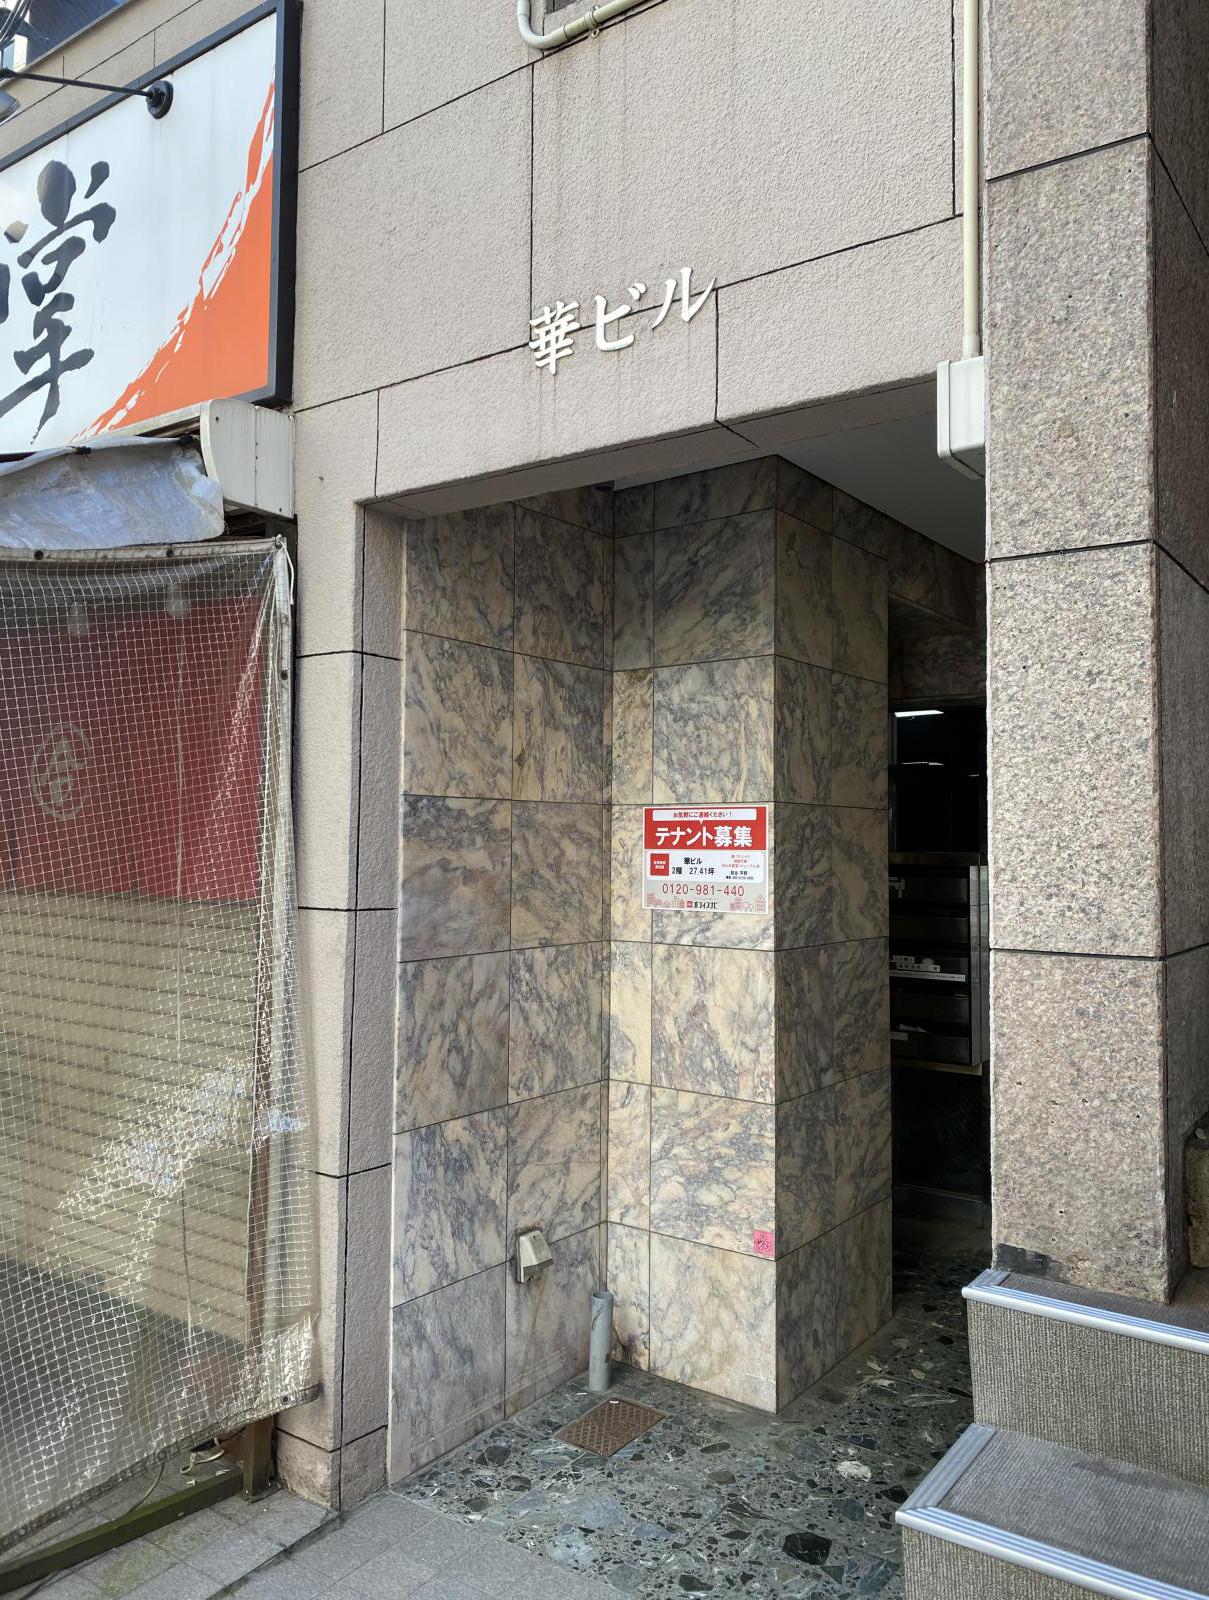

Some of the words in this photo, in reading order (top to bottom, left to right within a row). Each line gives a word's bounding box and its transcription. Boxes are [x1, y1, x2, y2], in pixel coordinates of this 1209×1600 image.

[528, 266, 718, 376] 華ビル
[655, 825, 753, 848] テナント募集
[671, 866, 683, 875] 2階
[689, 867, 715, 876] 27.41坪
[662, 883, 745, 897] 0120-981-440
